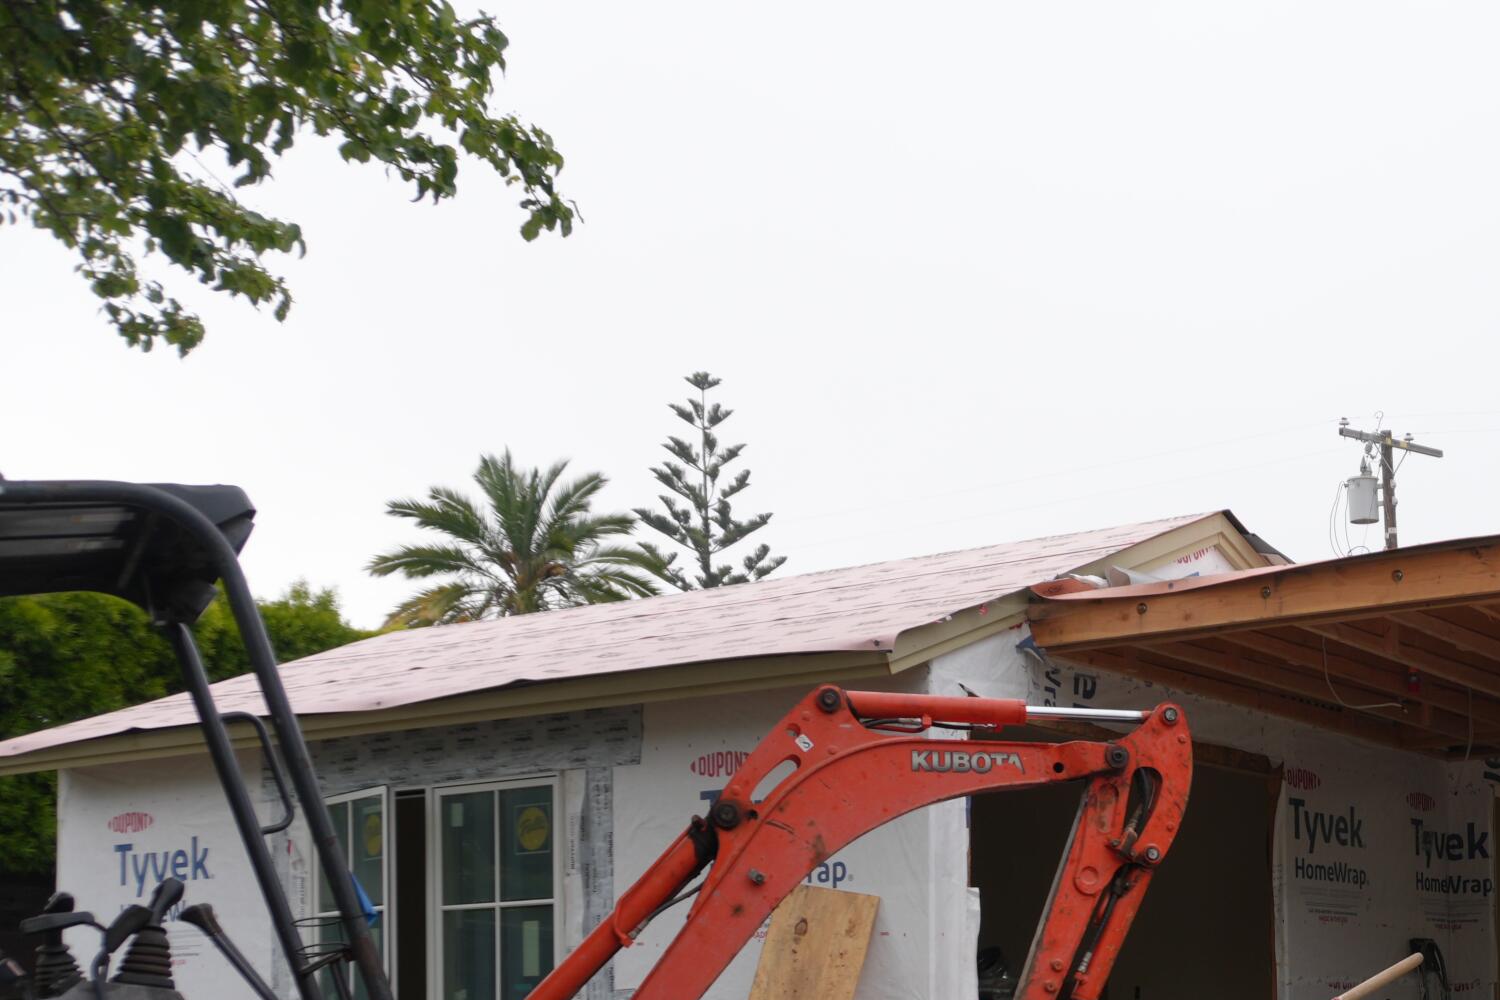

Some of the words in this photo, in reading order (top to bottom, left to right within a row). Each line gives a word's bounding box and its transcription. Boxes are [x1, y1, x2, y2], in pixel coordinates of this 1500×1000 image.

[911, 749, 1026, 775] KUBOTA
[1287, 768, 1318, 791] DUPONT
[1409, 791, 1434, 812] DUPONT
[112, 812, 149, 834] DUPONT
[1289, 797, 1364, 854] Tyvek
[1410, 817, 1489, 869] Tyvek
[113, 836, 210, 898] Tyvek
[1294, 856, 1368, 890] HomeWrap
